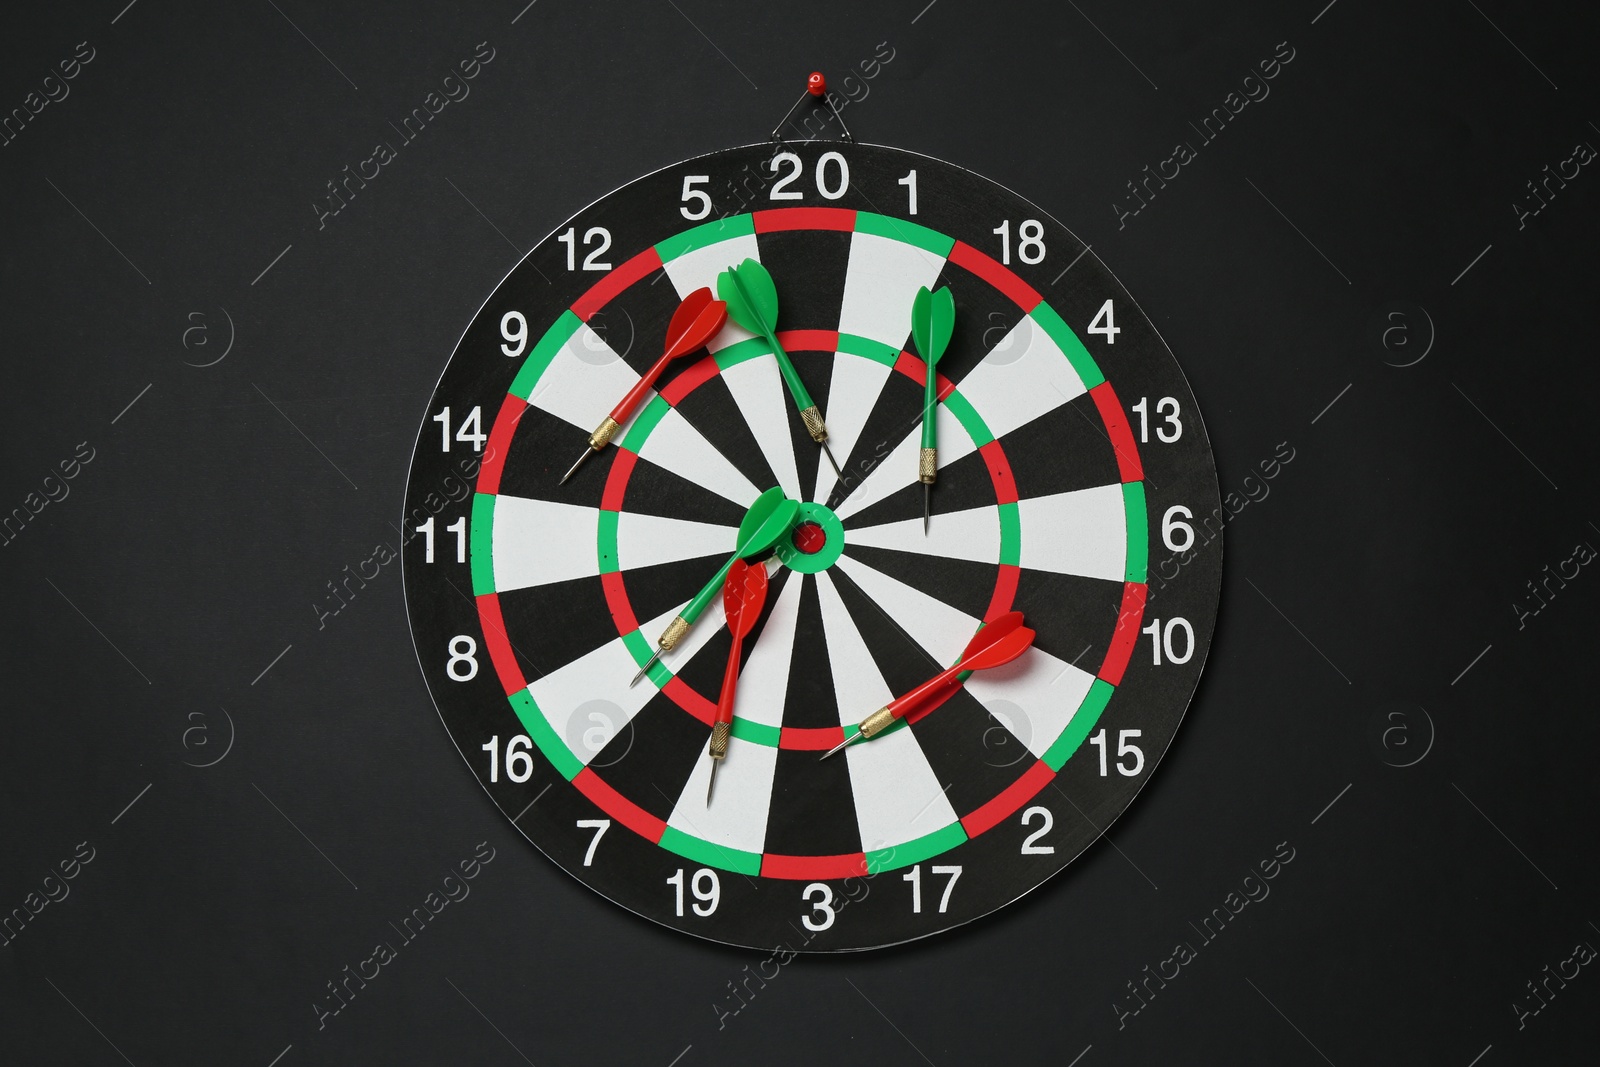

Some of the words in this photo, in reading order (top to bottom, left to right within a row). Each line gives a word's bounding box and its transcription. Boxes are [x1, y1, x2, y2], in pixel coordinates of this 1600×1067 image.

[679, 175, 713, 221] 5
[769, 151, 850, 201] 20
[897, 169, 918, 216] 1
[557, 226, 613, 271] 12
[992, 219, 1047, 265] 18
[500, 310, 529, 358] 9
[1087, 298, 1121, 345] 4
[433, 406, 488, 453] 14
[1131, 396, 1183, 444] 13
[415, 516, 466, 564] 11
[1161, 504, 1195, 553] 6
[446, 634, 479, 682] 8
[1142, 616, 1195, 666] 10
[482, 734, 534, 784] 16
[1089, 728, 1145, 777] 15
[576, 819, 611, 867] 7
[1020, 805, 1055, 855] 2
[666, 868, 721, 917] 19
[801, 882, 836, 932] 3
[902, 865, 963, 914] 17
